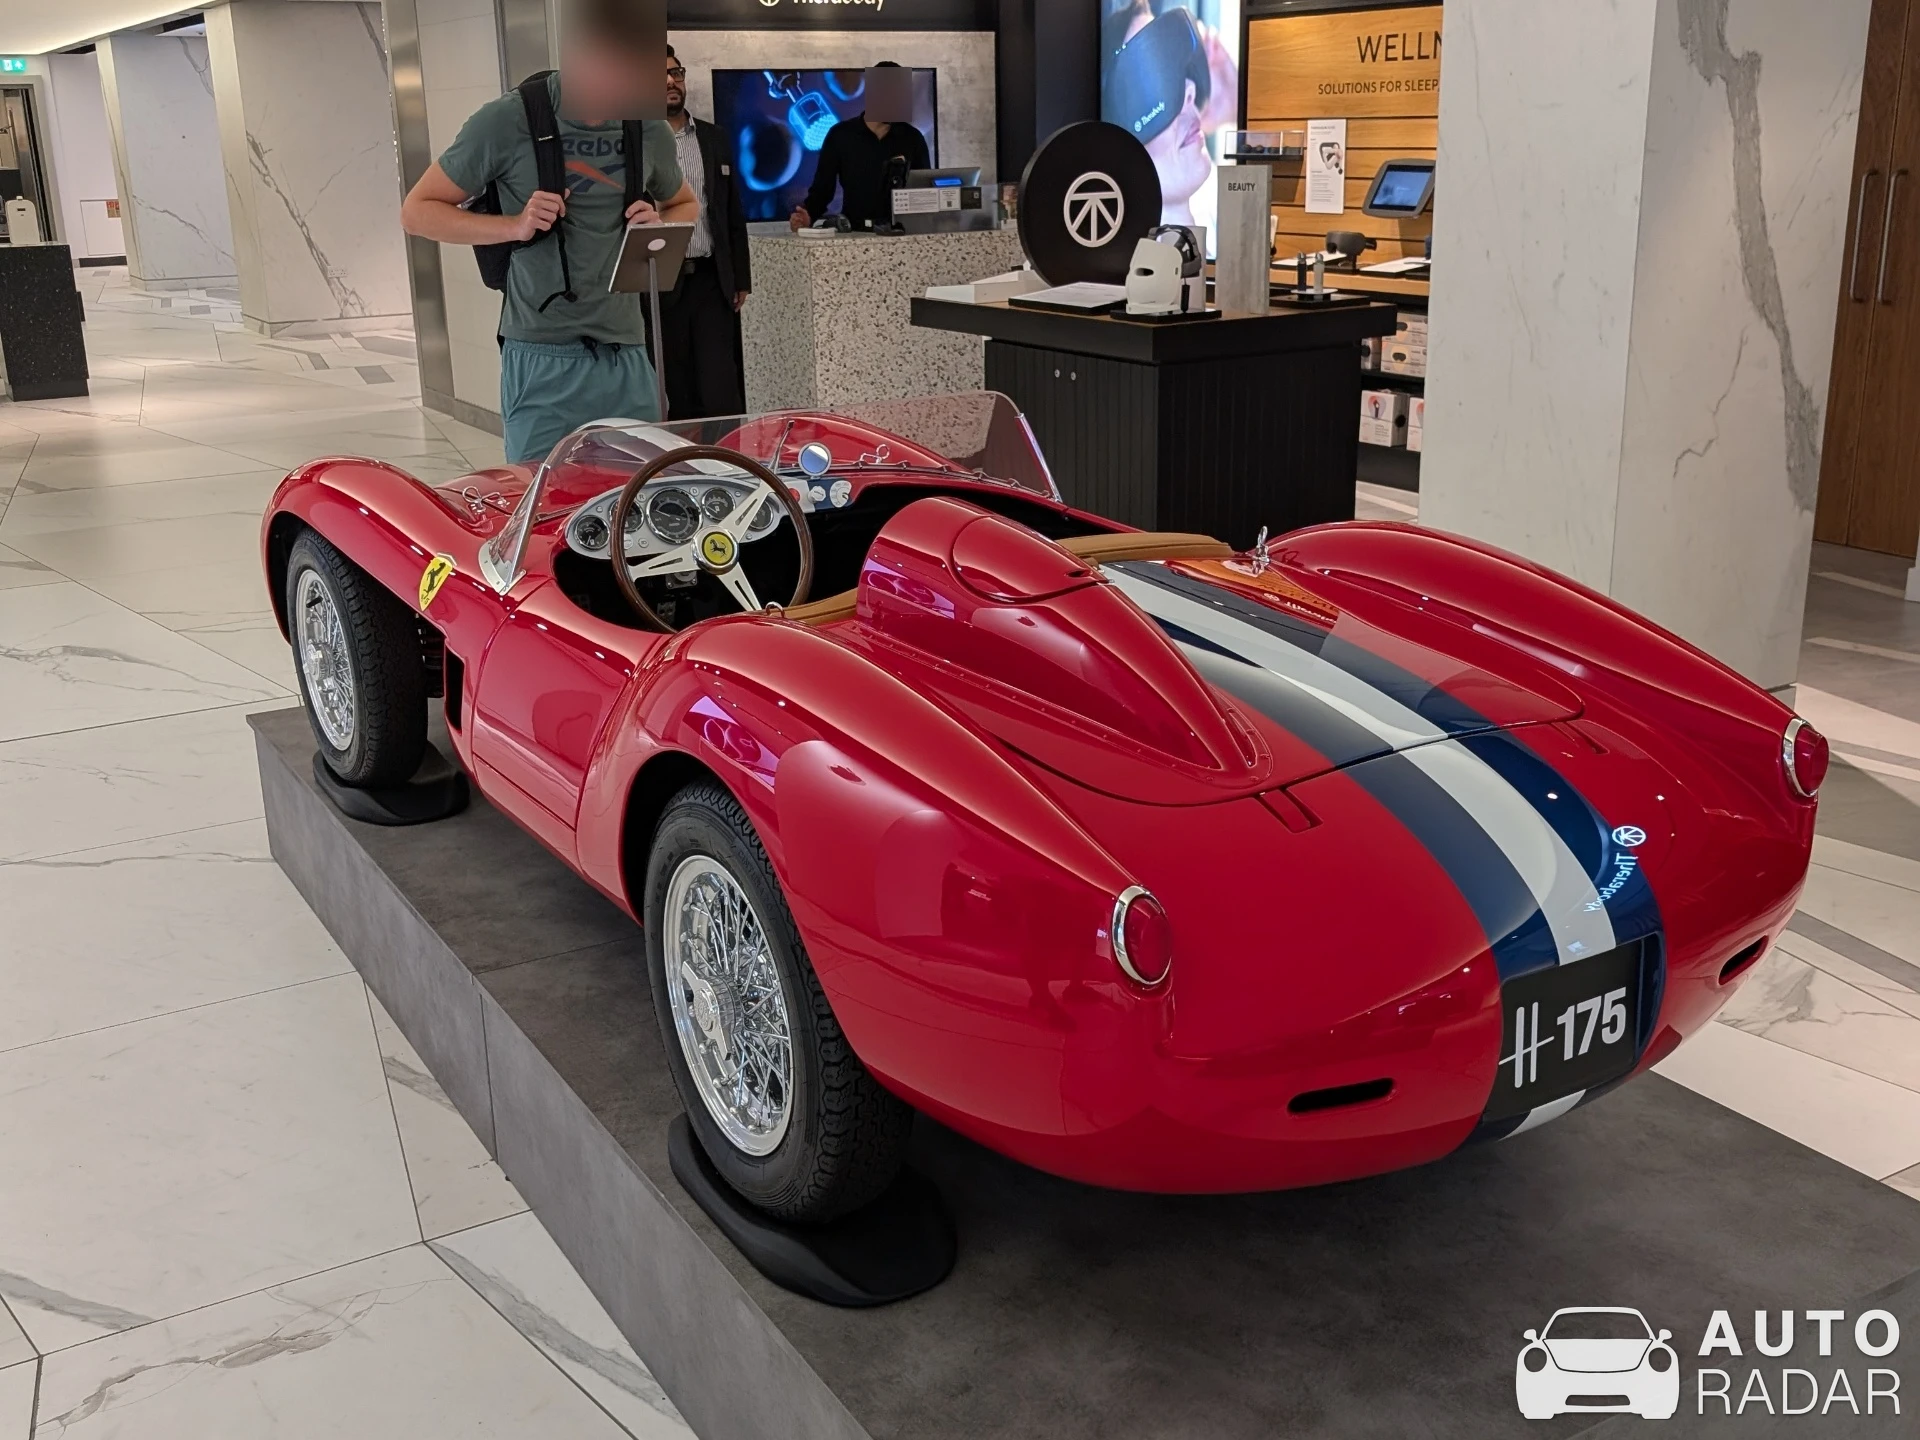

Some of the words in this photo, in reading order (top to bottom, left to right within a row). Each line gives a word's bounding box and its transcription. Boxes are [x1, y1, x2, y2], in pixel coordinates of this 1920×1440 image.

[1318, 81, 1377, 95] SOLUTIONS
[1380, 80, 1402, 93] FOR
[561, 137, 625, 157] eebo
[1227, 182, 1256, 192] BEAUTY
[1556, 986, 1627, 1061] 175
